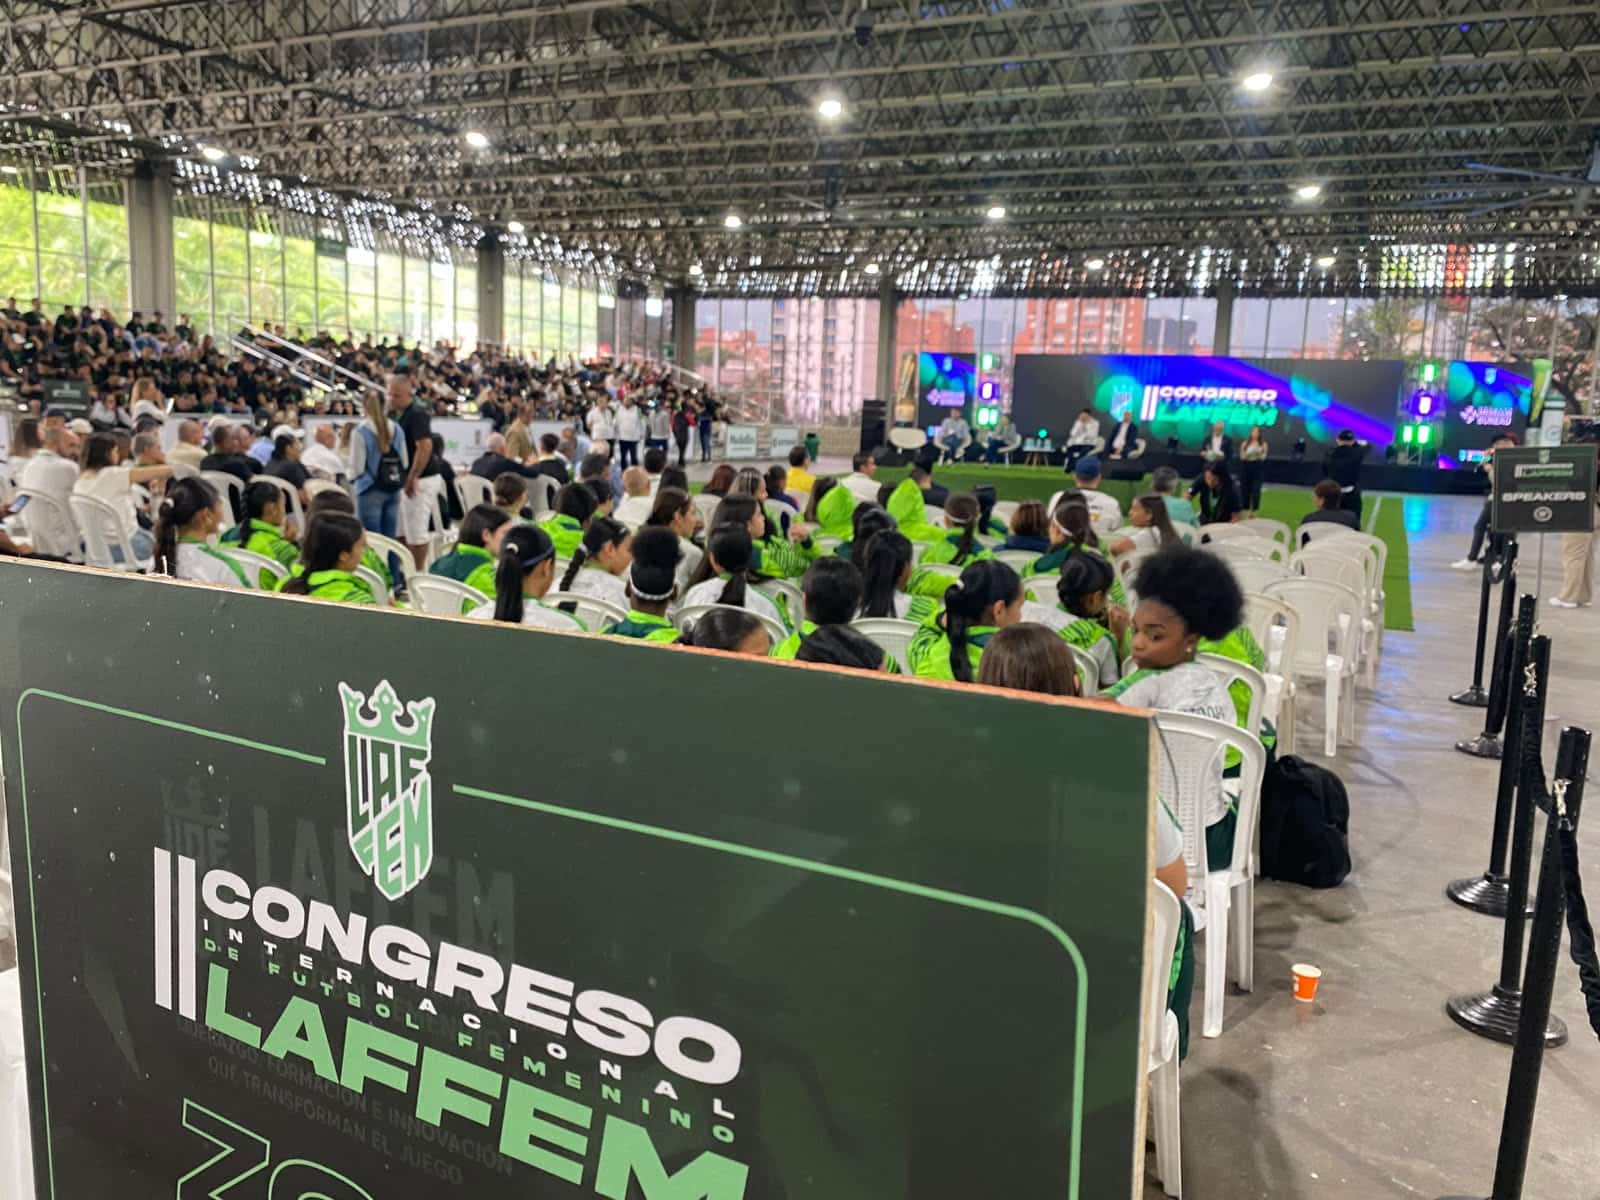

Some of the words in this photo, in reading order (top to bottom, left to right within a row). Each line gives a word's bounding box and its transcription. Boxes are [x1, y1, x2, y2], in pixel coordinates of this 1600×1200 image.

[1156, 402, 1279, 426] LAFFEM
[1502, 491, 1586, 502] SPEAKERS
[202, 869, 741, 1084] CONGRESO
[203, 918, 735, 1119] INTERNACIONAL
[204, 938, 239, 961] DE
[268, 962, 419, 1030] FUTBOL
[458, 1031, 735, 1143] FEMENINO
[205, 963, 749, 1200] LAFFEM
